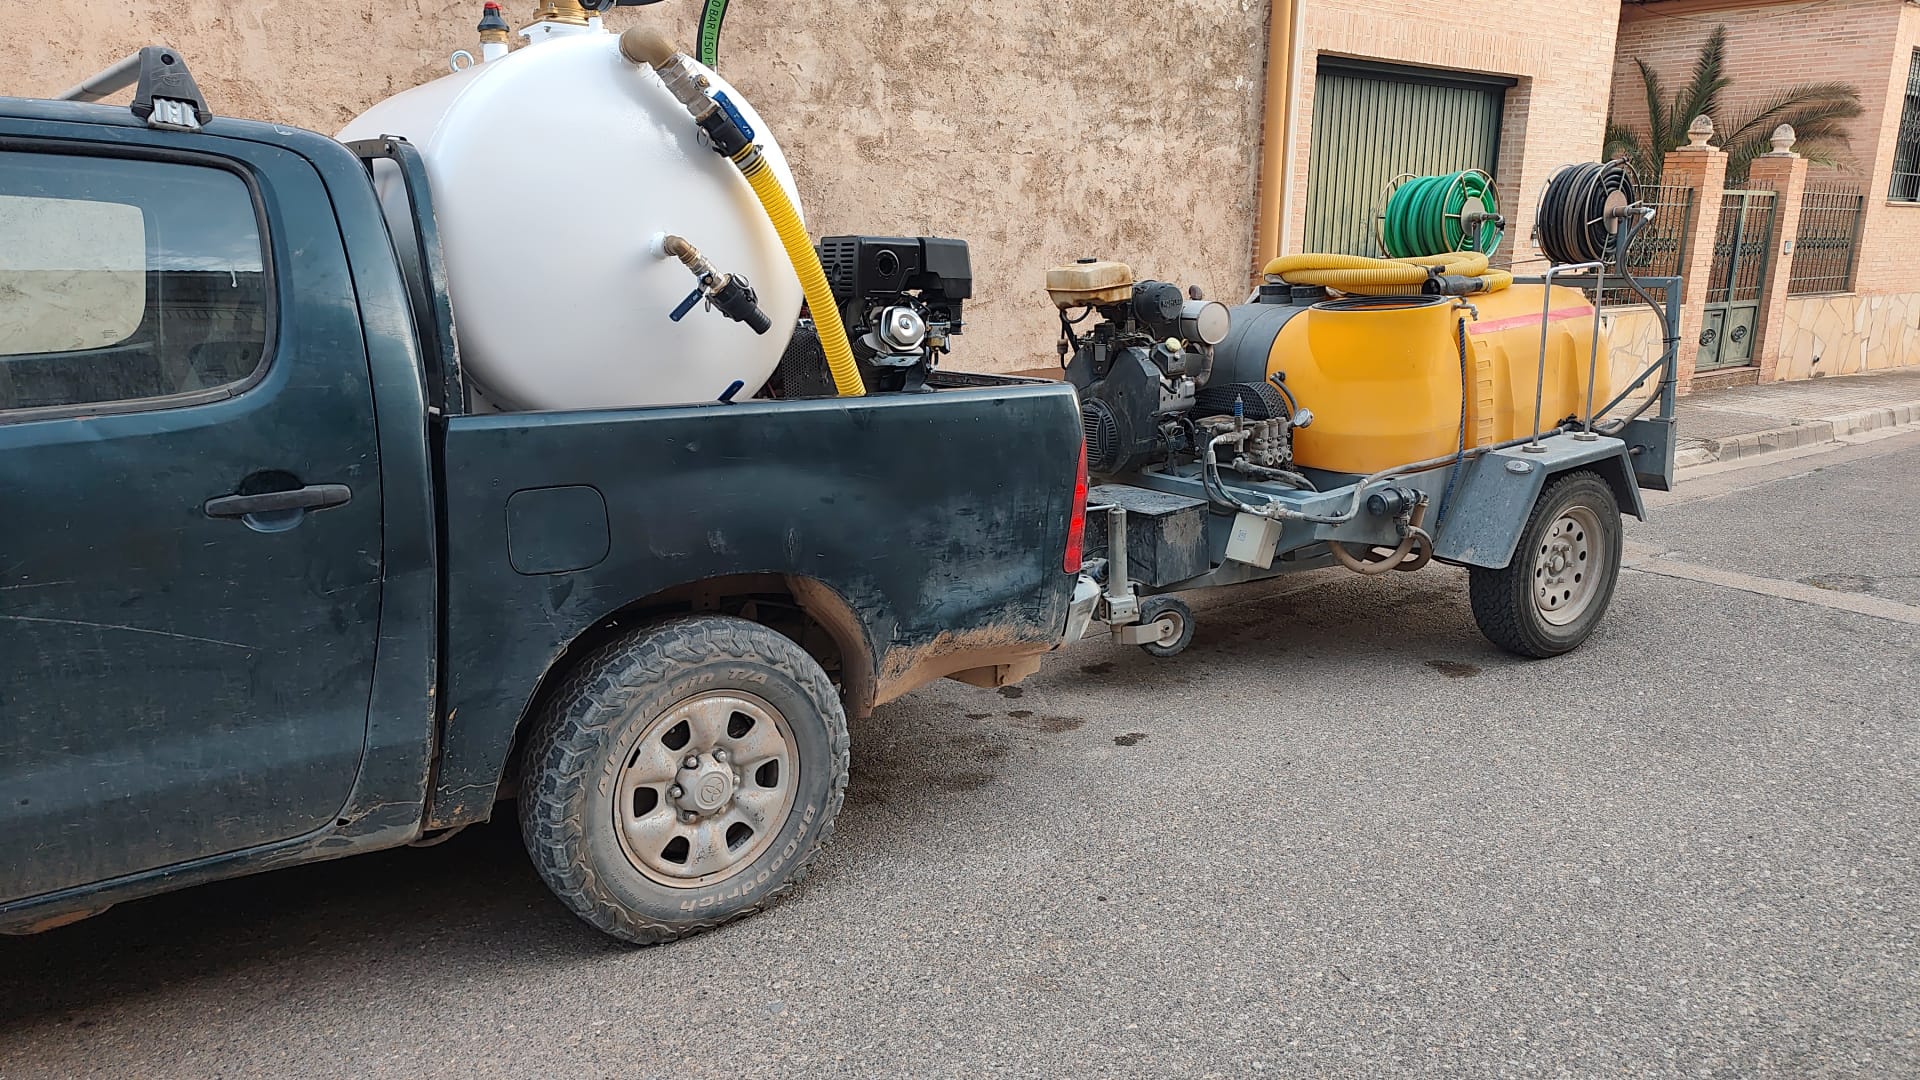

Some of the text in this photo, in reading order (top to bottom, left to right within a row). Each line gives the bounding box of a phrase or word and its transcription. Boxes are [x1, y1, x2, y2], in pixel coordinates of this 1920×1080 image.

[707, 9, 719, 30] BAR
[703, 31, 715, 54] (150
[727, 668, 769, 685] T/A
[679, 803, 816, 912] BFGoodrich
